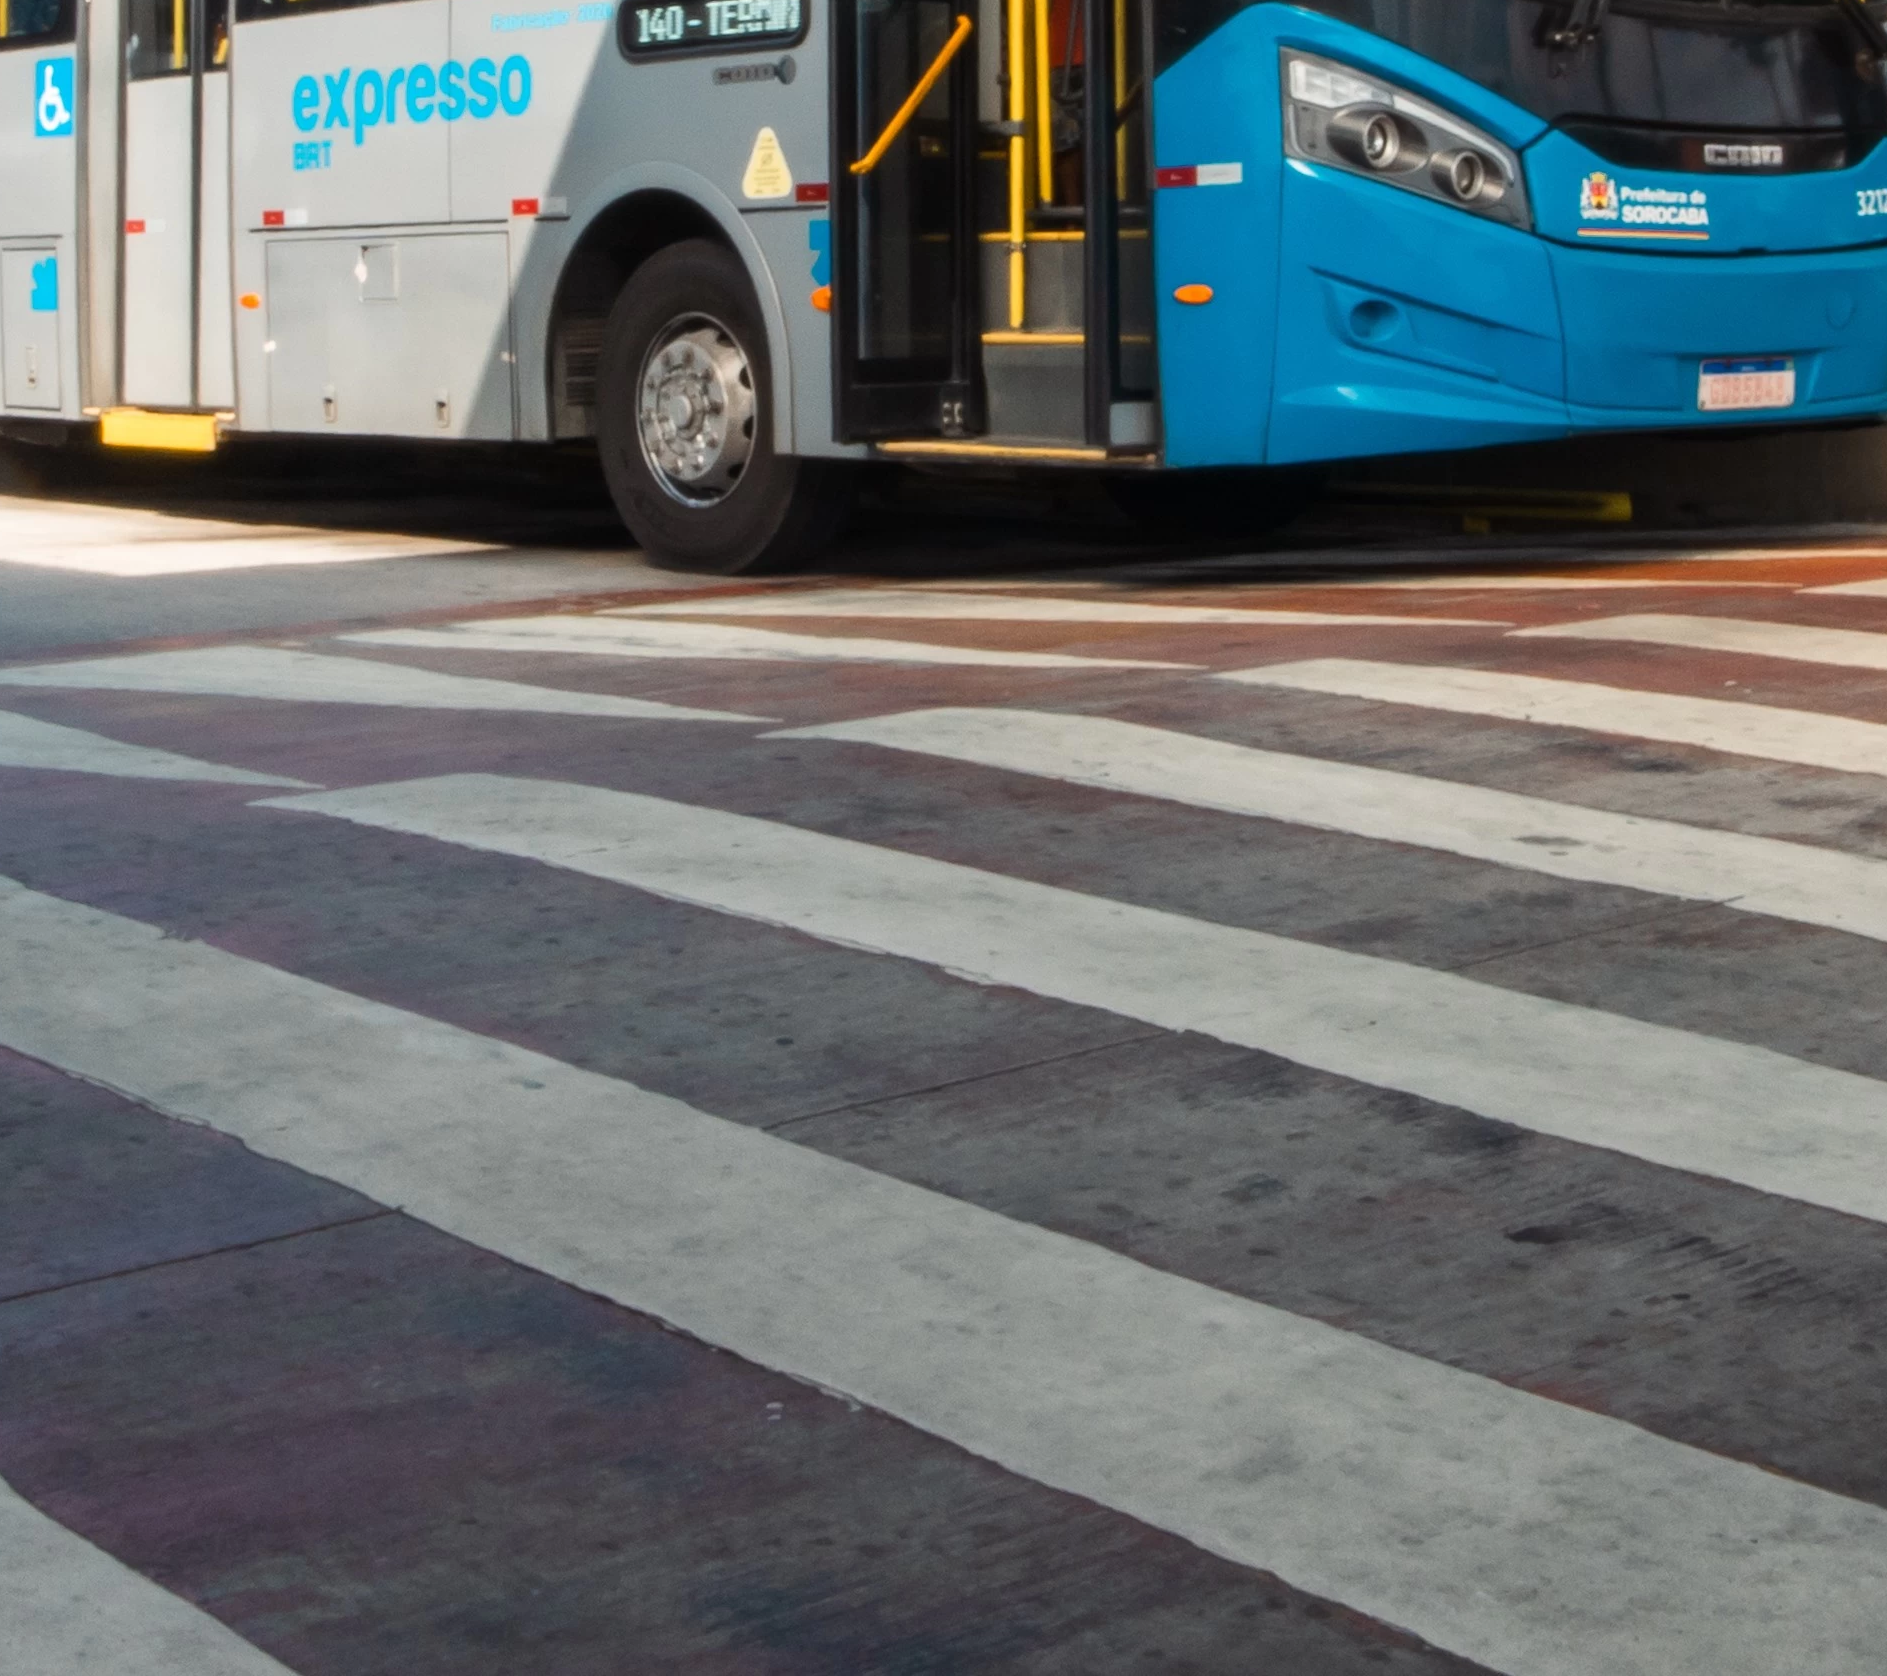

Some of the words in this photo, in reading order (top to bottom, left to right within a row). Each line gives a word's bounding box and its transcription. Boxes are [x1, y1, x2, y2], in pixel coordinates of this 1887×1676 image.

[292, 54, 532, 147] expresso
[293, 140, 332, 170] BRT
[1620, 187, 1688, 204] Prefeitura
[1689, 189, 1707, 205] de
[1621, 205, 1709, 225] SOROCABA
